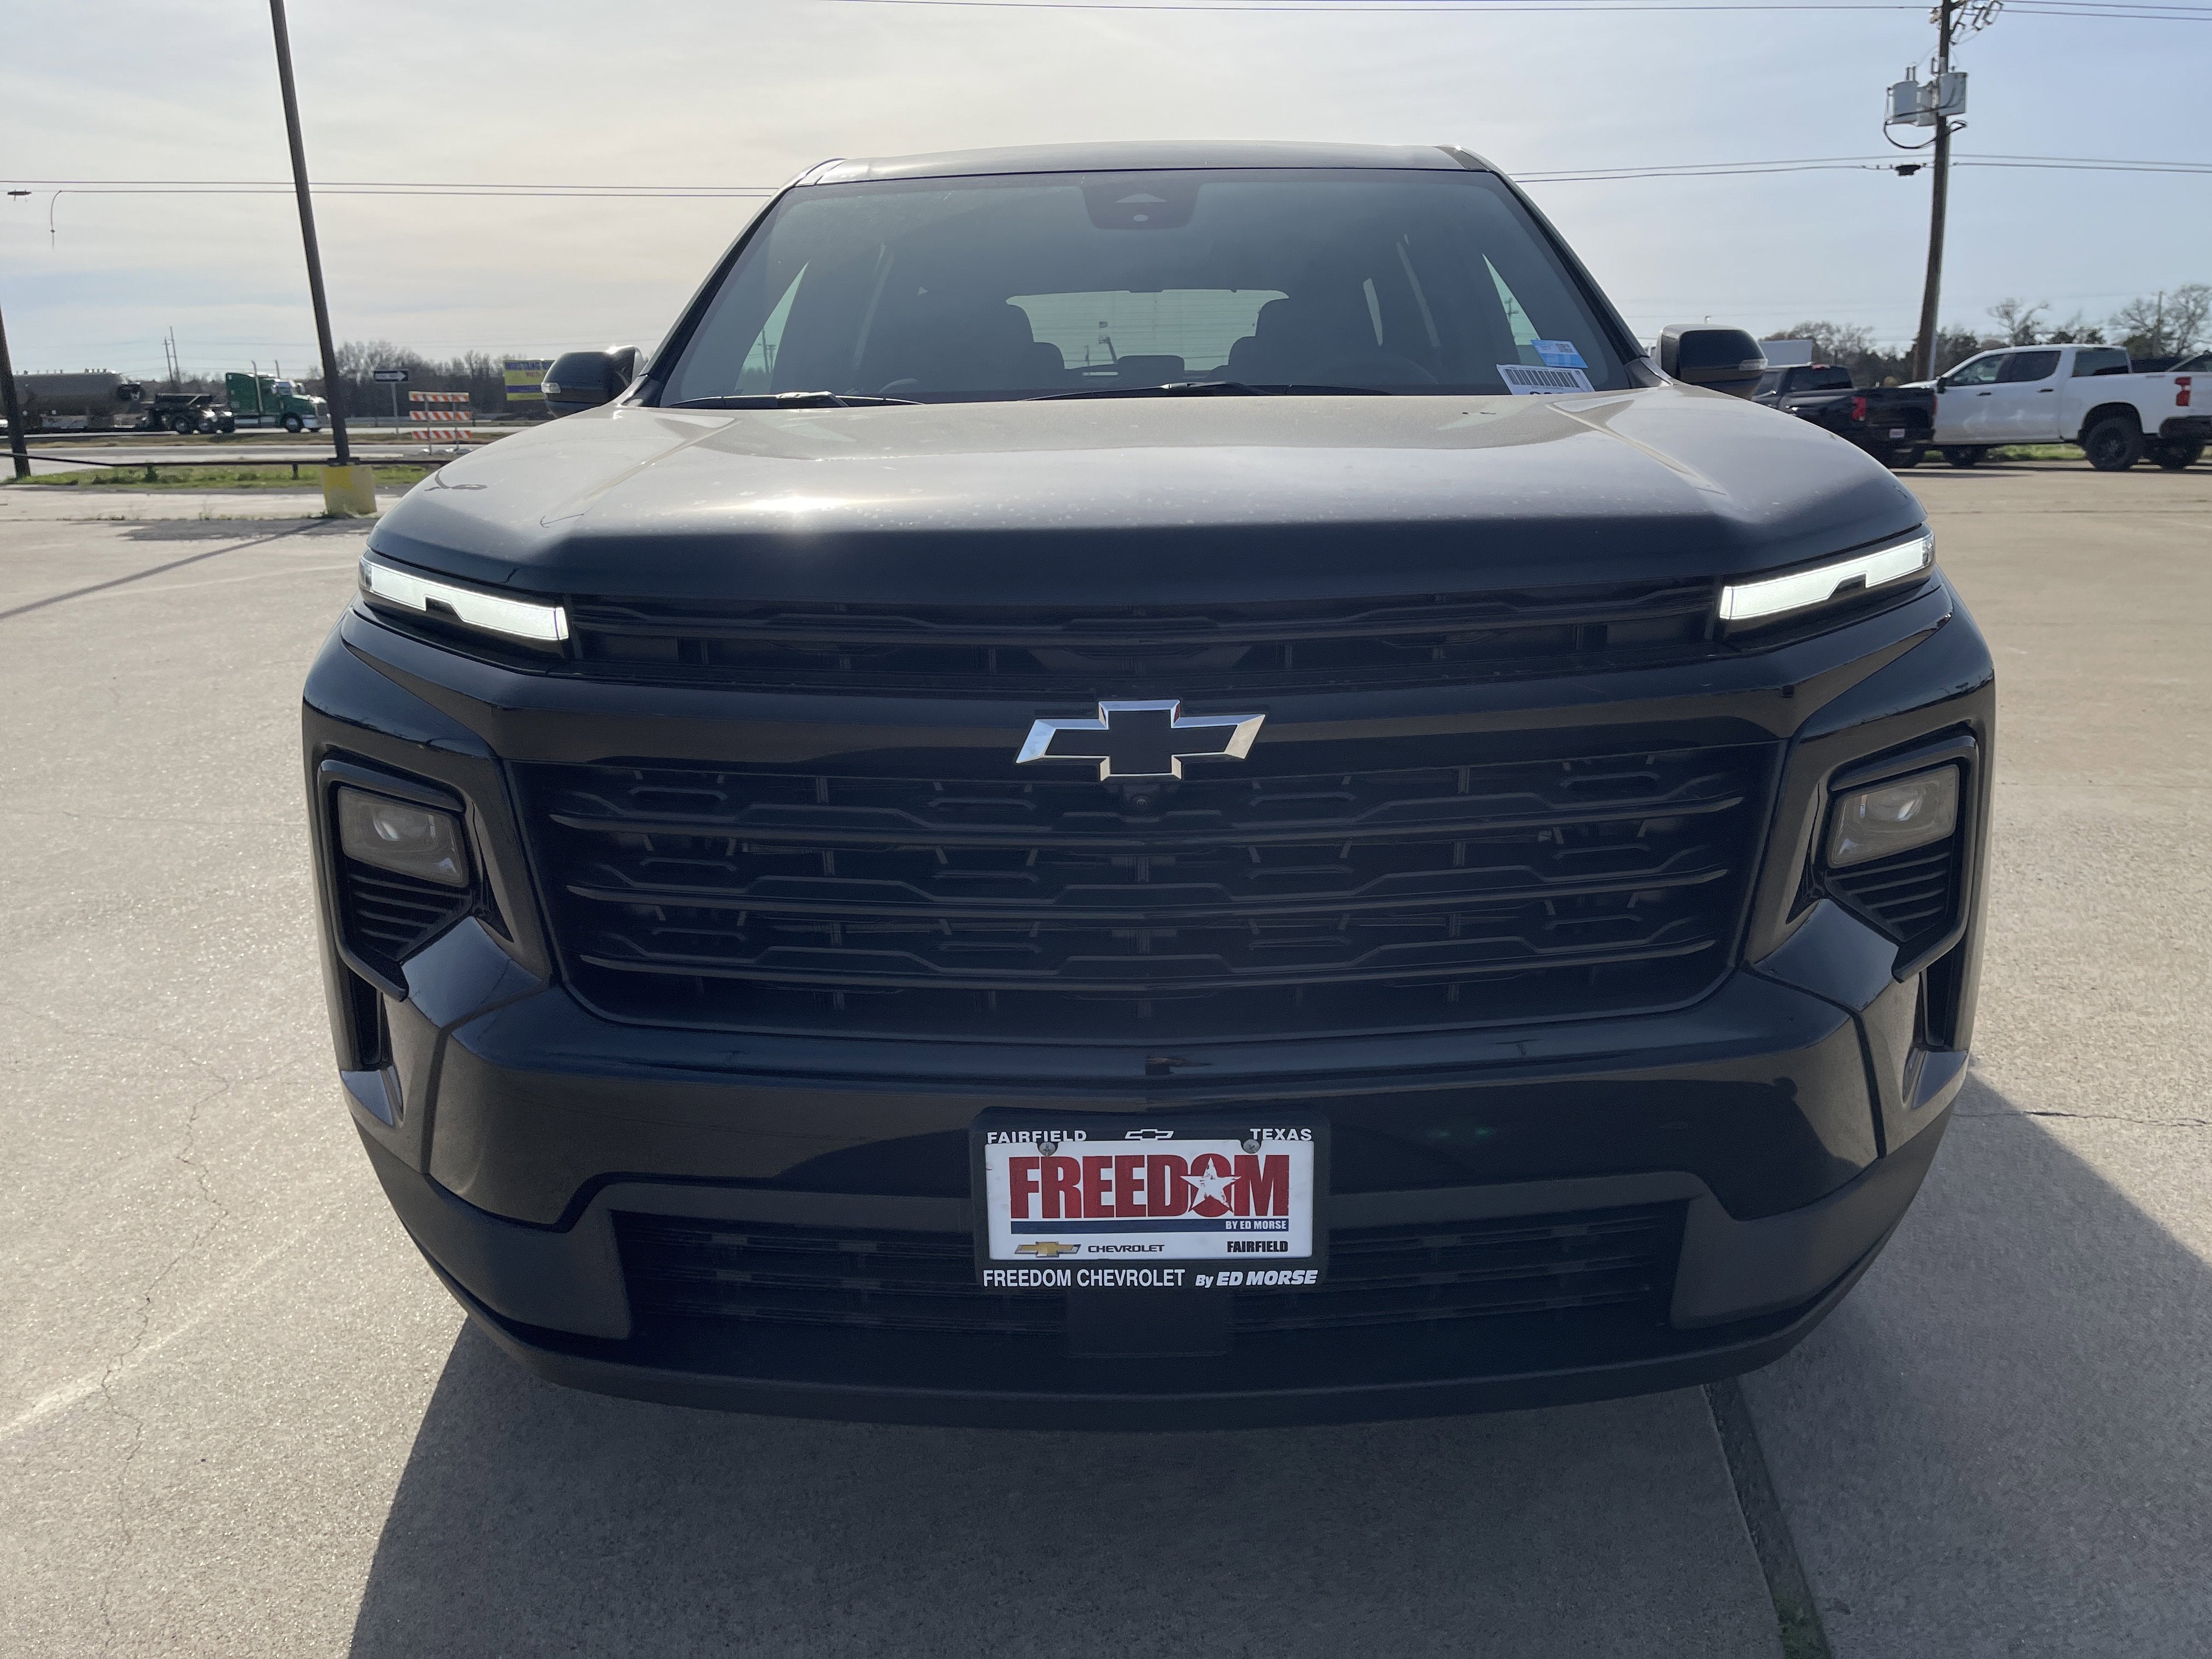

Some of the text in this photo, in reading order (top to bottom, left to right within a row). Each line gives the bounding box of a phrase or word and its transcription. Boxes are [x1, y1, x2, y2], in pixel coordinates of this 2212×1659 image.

[988, 1128, 1312, 1143] FAIRFIELD TEXAS
[1009, 1153, 1290, 1218] FREEDOM
[1226, 1219, 1287, 1229] BY ED MORSE
[1088, 1244, 1165, 1254] CHEVROLET
[1227, 1240, 1288, 1253] FAIRFIELD
[983, 1269, 1318, 1288] FREEDOM CHEVROLET By ED MORSE
